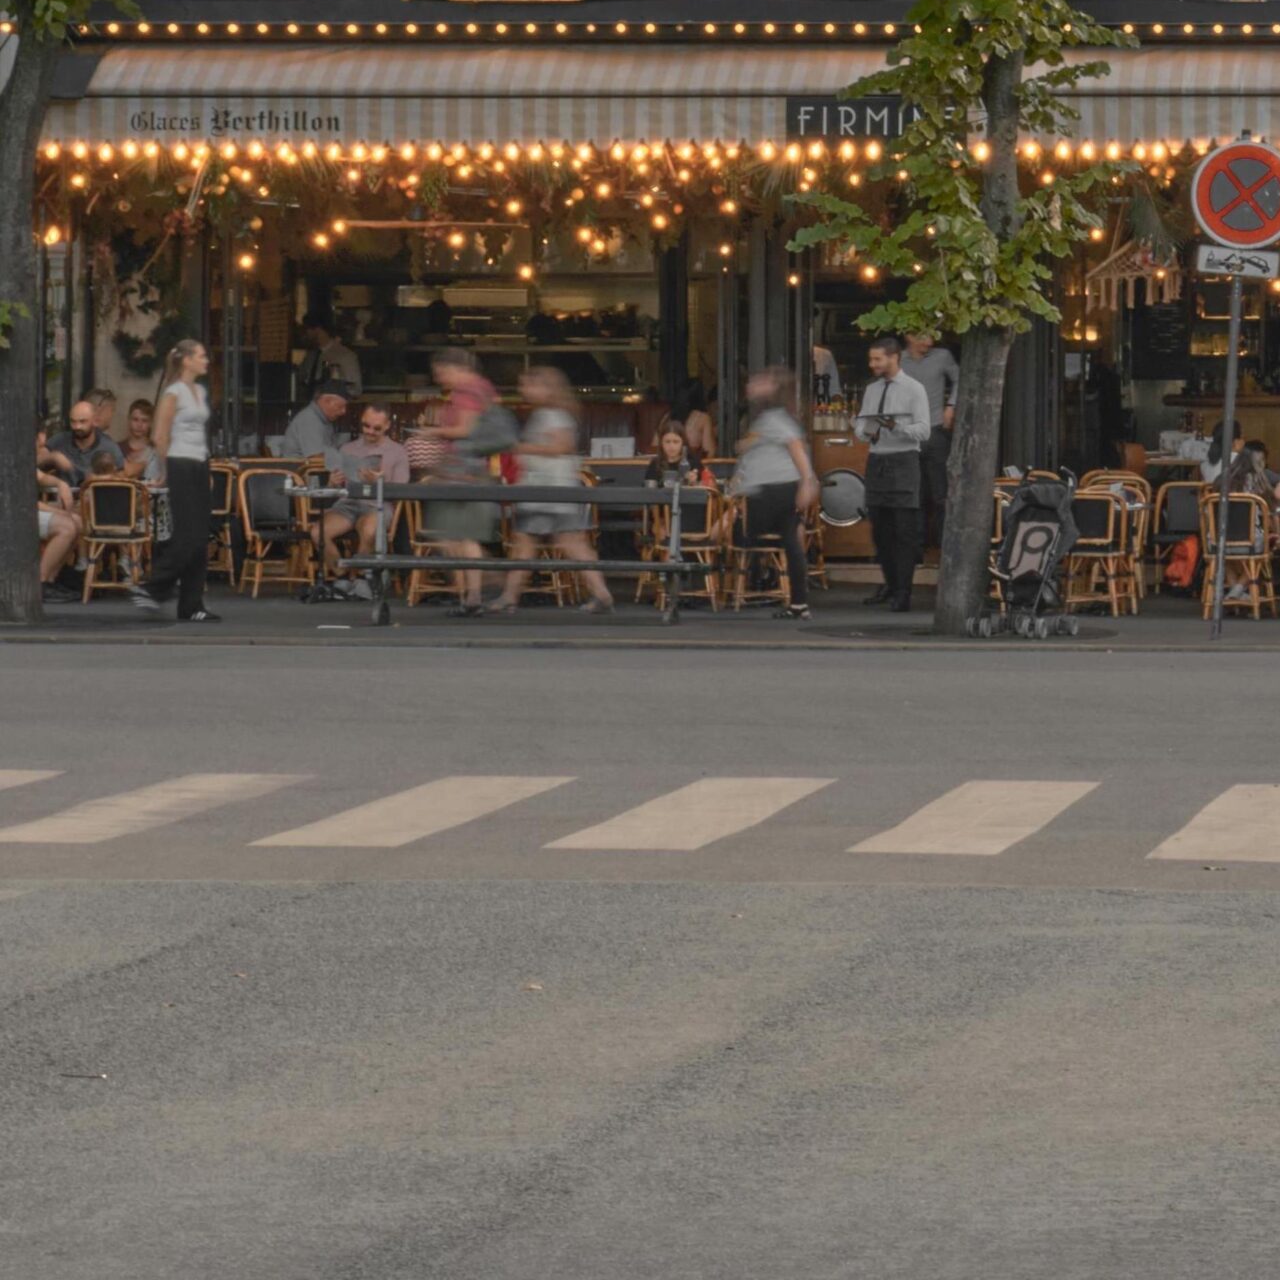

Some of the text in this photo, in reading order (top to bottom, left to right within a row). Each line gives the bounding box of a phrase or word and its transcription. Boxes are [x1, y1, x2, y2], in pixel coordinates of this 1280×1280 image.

[130, 106, 342, 137] Glaces Berthillon
[797, 105, 956, 136] FIRMI
